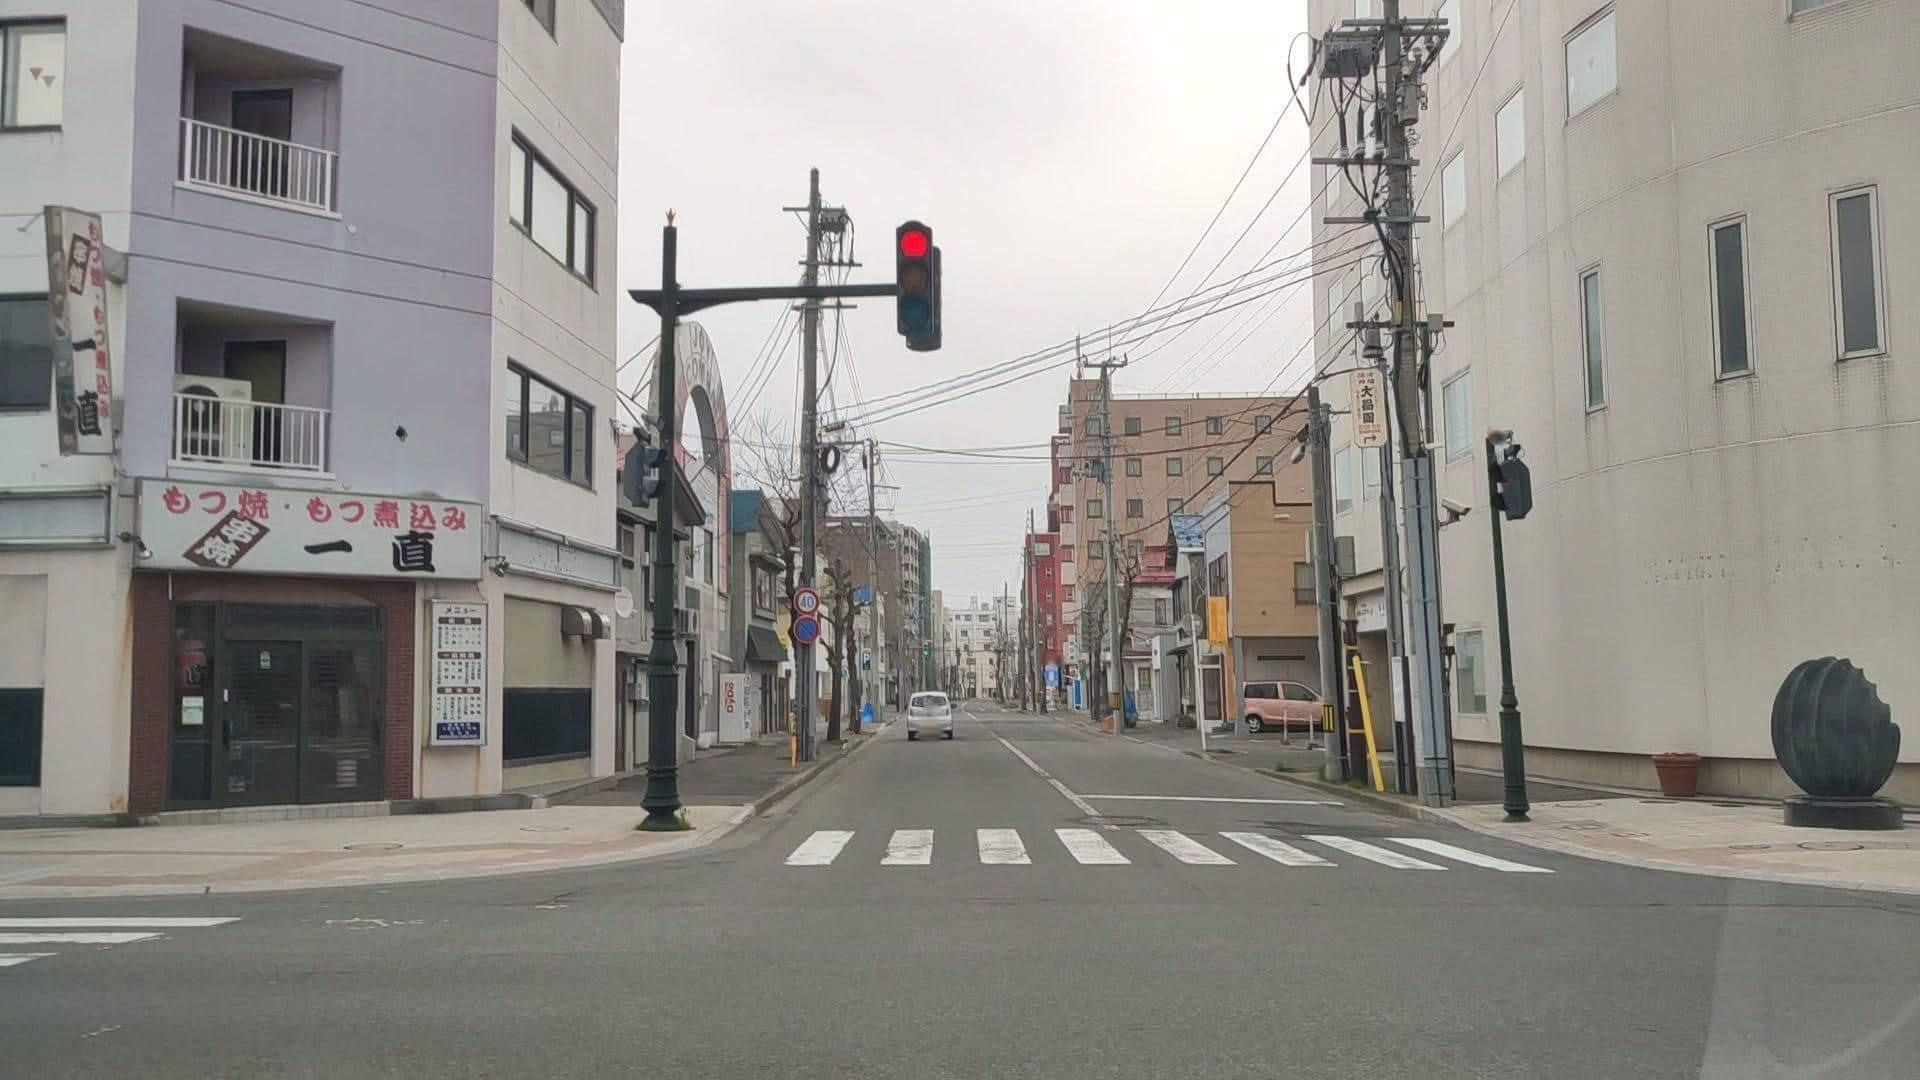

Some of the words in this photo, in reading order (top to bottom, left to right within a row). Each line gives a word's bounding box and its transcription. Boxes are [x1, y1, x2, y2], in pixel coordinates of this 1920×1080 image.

[72, 338, 102, 436] 一直
[304, 530, 436, 573] 一直
[801, 596, 814, 608] 40
